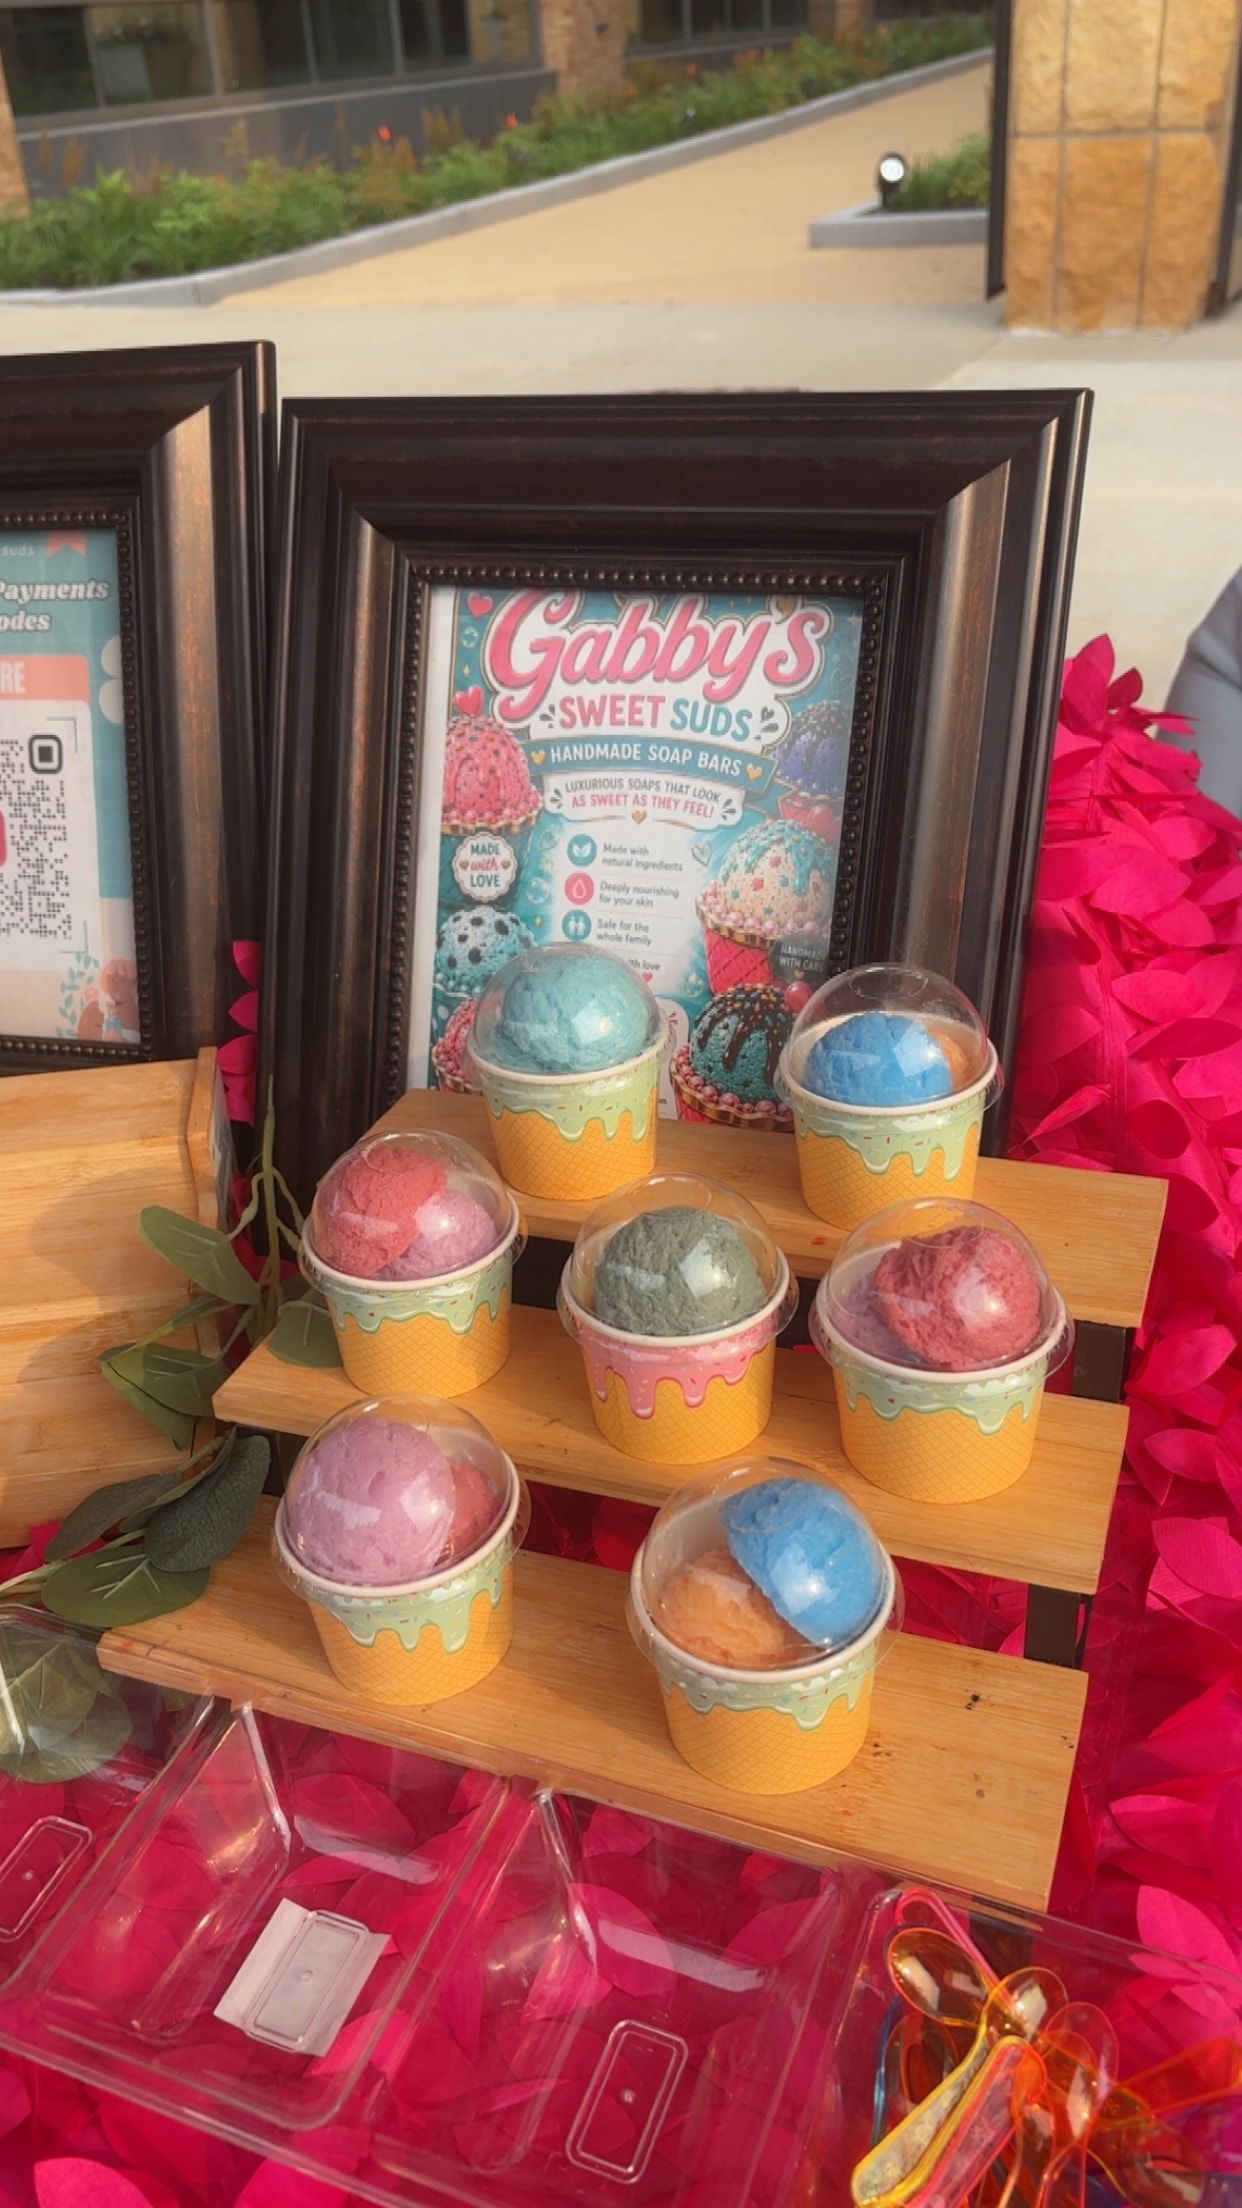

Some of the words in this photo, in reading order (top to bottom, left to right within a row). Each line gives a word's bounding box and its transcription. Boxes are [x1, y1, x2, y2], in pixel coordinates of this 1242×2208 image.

[489, 587, 826, 721] Gabby's
[559, 693, 666, 730] SWEET
[670, 697, 753, 742] SUDS
[550, 743, 642, 763] HANDMADE
[648, 744, 693, 765] SOAP
[697, 752, 742, 776] BARS
[564, 778, 624, 793] LUXURIOUS
[627, 778, 661, 792] SOAPS
[665, 782, 690, 796] THAT
[692, 787, 721, 803] LOOK
[571, 795, 587, 809] AS
[590, 794, 629, 807] SWEET
[632, 794, 648, 807] AS
[652, 795, 681, 812] THEY
[683, 803, 715, 819] FEEL!
[470, 842, 501, 855] MADE
[602, 843, 627, 855] Made
[629, 845, 650, 856] with
[470, 857, 498, 871] with
[601, 857, 633, 867] natural
[635, 859, 683, 872] ingredients
[469, 874, 501, 888] LOVE
[600, 880, 631, 895] Deeply
[632, 885, 680, 900] nourishing
[598, 893, 612, 904] for
[613, 897, 635, 907] your
[636, 897, 654, 908] skin
[597, 918, 618, 929] Safe
[619, 919, 633, 930] for
[634, 921, 650, 933] the
[596, 932, 623, 943] whole
[625, 933, 653, 948] family
[642, 959, 661, 971] love
[779, 955, 801, 969] WITH
